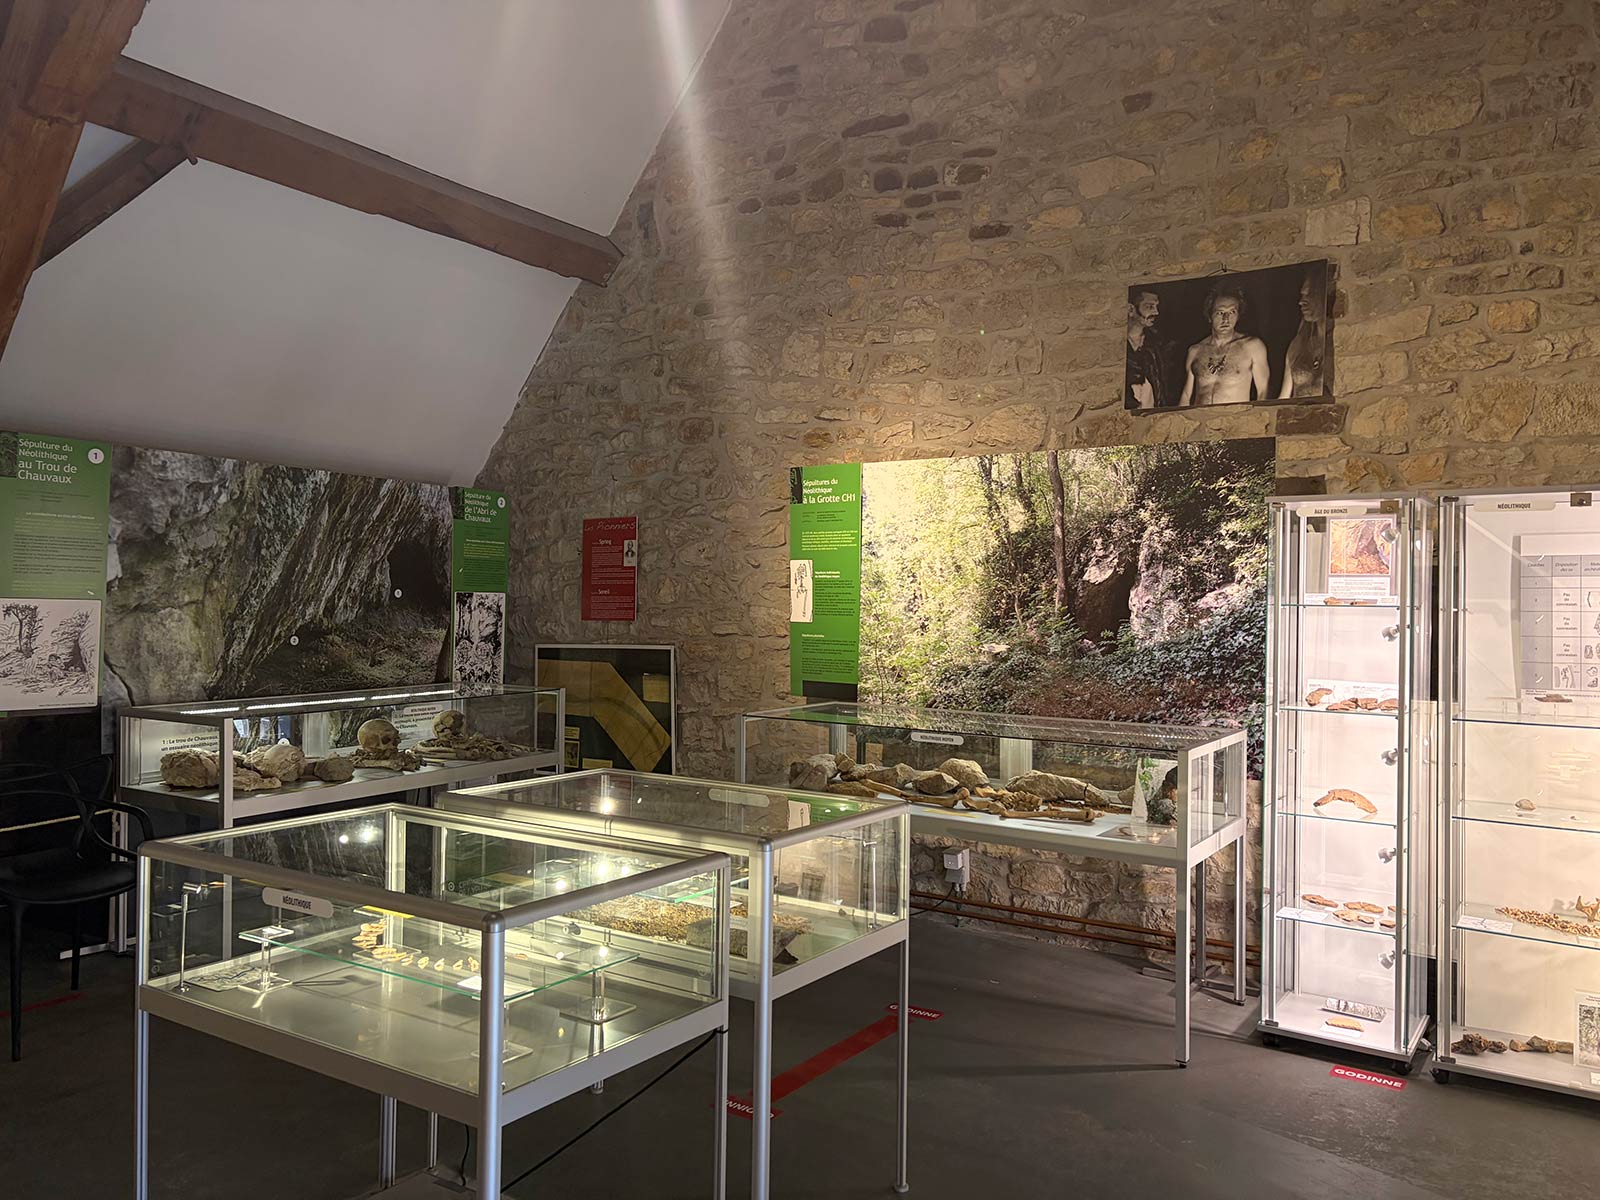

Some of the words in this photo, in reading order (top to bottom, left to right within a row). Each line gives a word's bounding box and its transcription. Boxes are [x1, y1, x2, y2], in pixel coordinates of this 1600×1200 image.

[18, 438, 61, 452] Sépulture
[62, 443, 74, 452] du
[18, 448, 69, 461] Néolithique
[18, 460, 33, 469] au
[36, 460, 61, 472] Trou
[63, 463, 78, 474] de
[18, 469, 72, 484] Chauvaux
[802, 479, 830, 487] Sépultures
[830, 477, 839, 485] du
[802, 486, 833, 495] Néolithique
[802, 495, 808, 504] à
[809, 495, 816, 504] la
[817, 494, 841, 504] Grotte
[841, 493, 856, 502] CH1
[464, 505, 473, 514] de
[473, 506, 489, 516] l'Abri
[489, 508, 498, 517] de
[464, 513, 492, 523] Chauvaux
[282, 895, 312, 910] NÉOLITHIQUE
[889, 1004, 941, 1018] GDINNE
[1333, 1068, 1403, 1088] GODINNE
